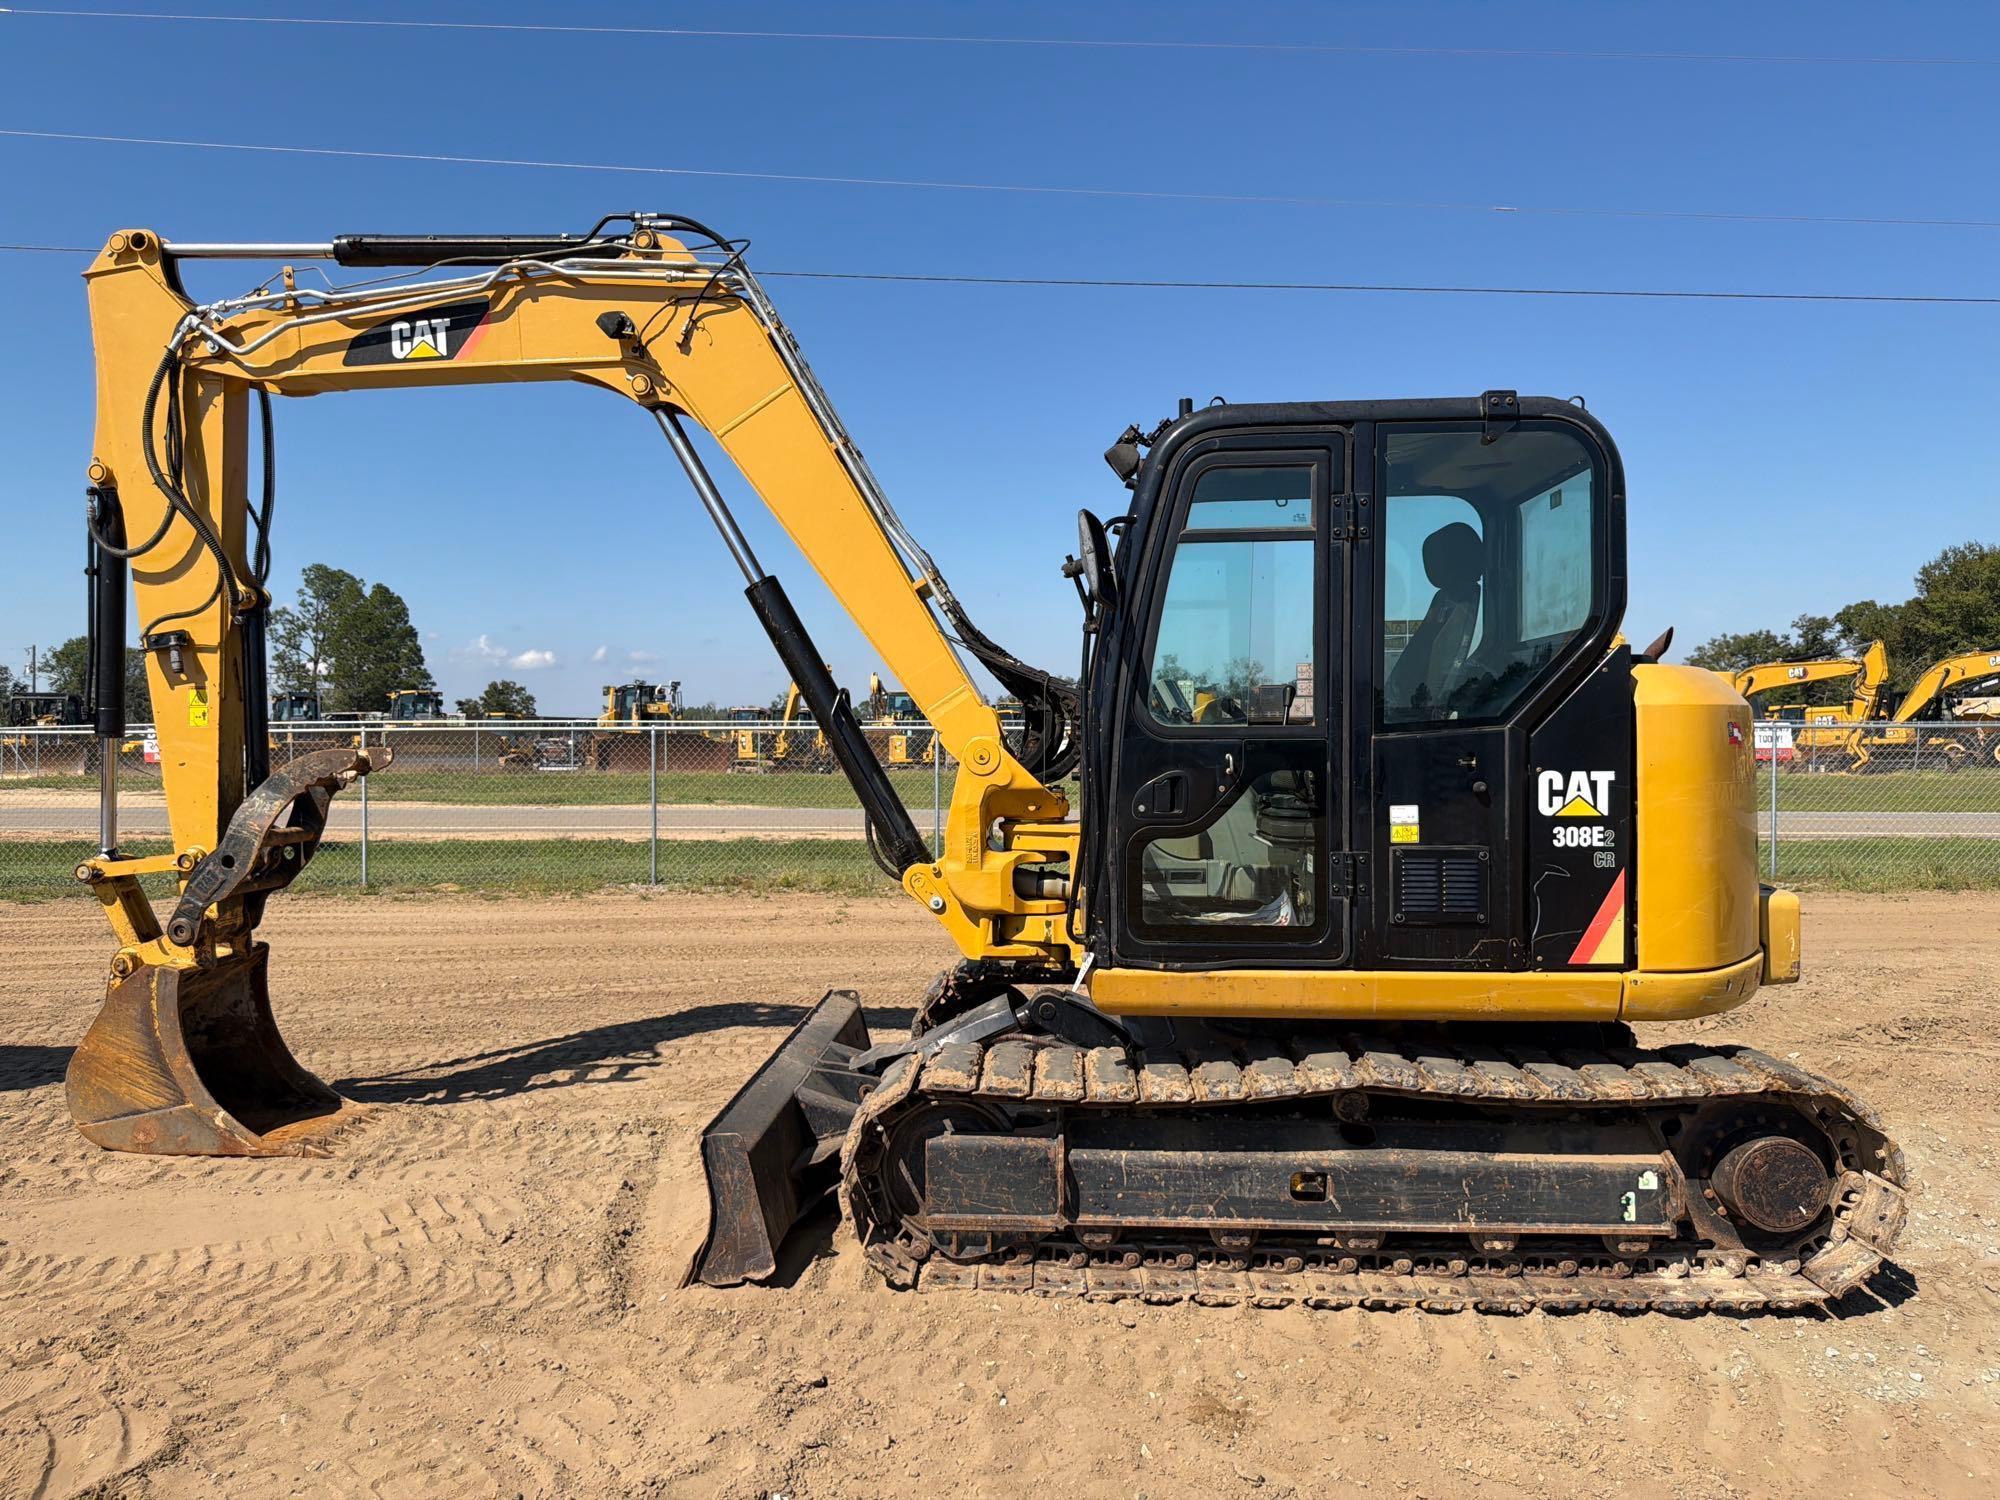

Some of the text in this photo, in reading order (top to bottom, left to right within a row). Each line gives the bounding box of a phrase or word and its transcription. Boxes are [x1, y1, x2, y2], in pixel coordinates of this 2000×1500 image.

[391, 317, 450, 359] CAT
[1788, 666, 1804, 678] CAT
[1815, 715, 1834, 726] CAT
[1758, 734, 1784, 743] TODY!
[1537, 770, 1616, 816] CAT
[1593, 851, 1616, 868] CR
